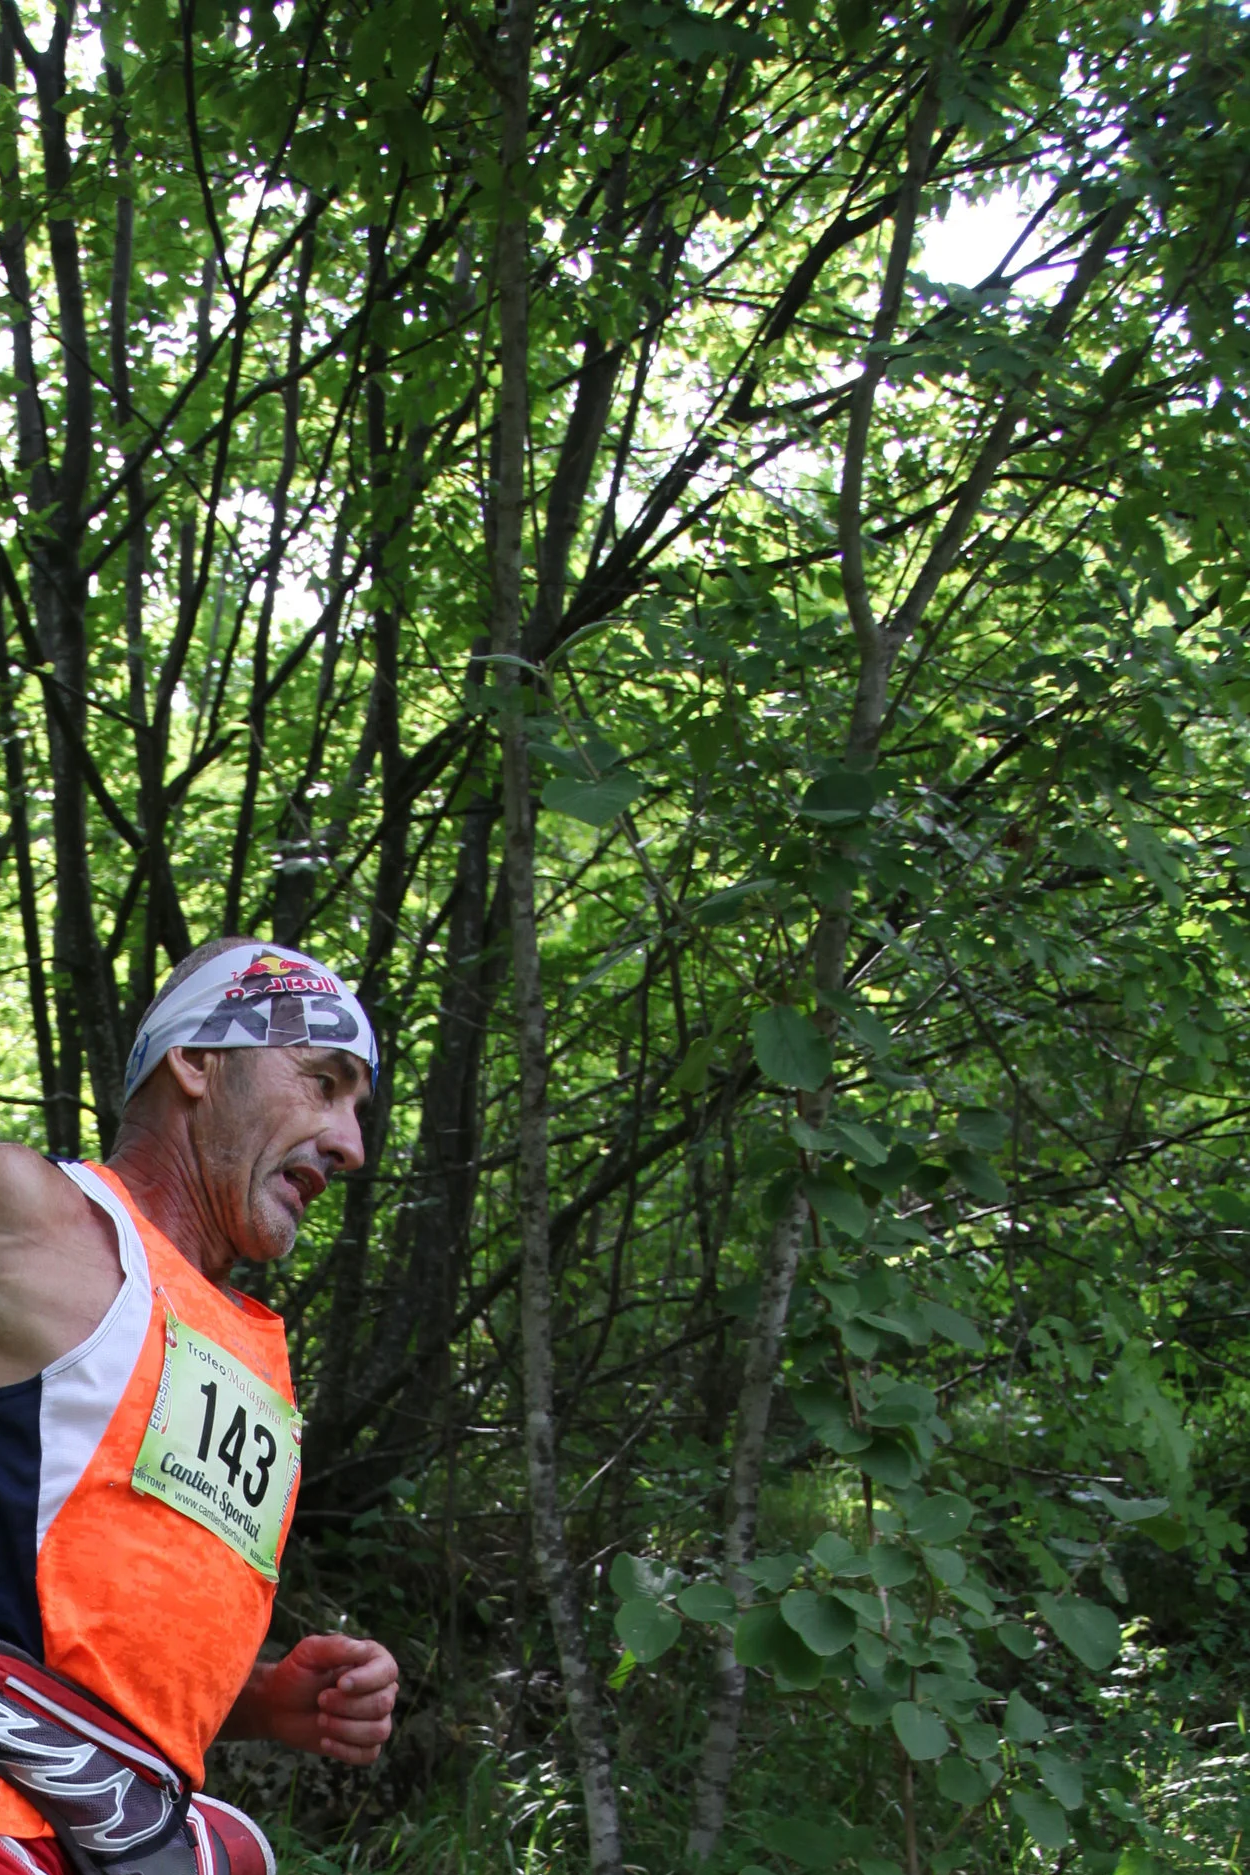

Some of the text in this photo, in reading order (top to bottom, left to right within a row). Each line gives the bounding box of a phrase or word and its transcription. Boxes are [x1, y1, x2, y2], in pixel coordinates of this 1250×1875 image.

[285, 976, 338, 994] Bull
[149, 1356, 171, 1430] EthicSport
[187, 1341, 226, 1376] Trofeo
[228, 1367, 281, 1426] Malaspina
[197, 1380, 277, 1508] 143
[160, 1452, 261, 1543] Cantieri Sportivi
